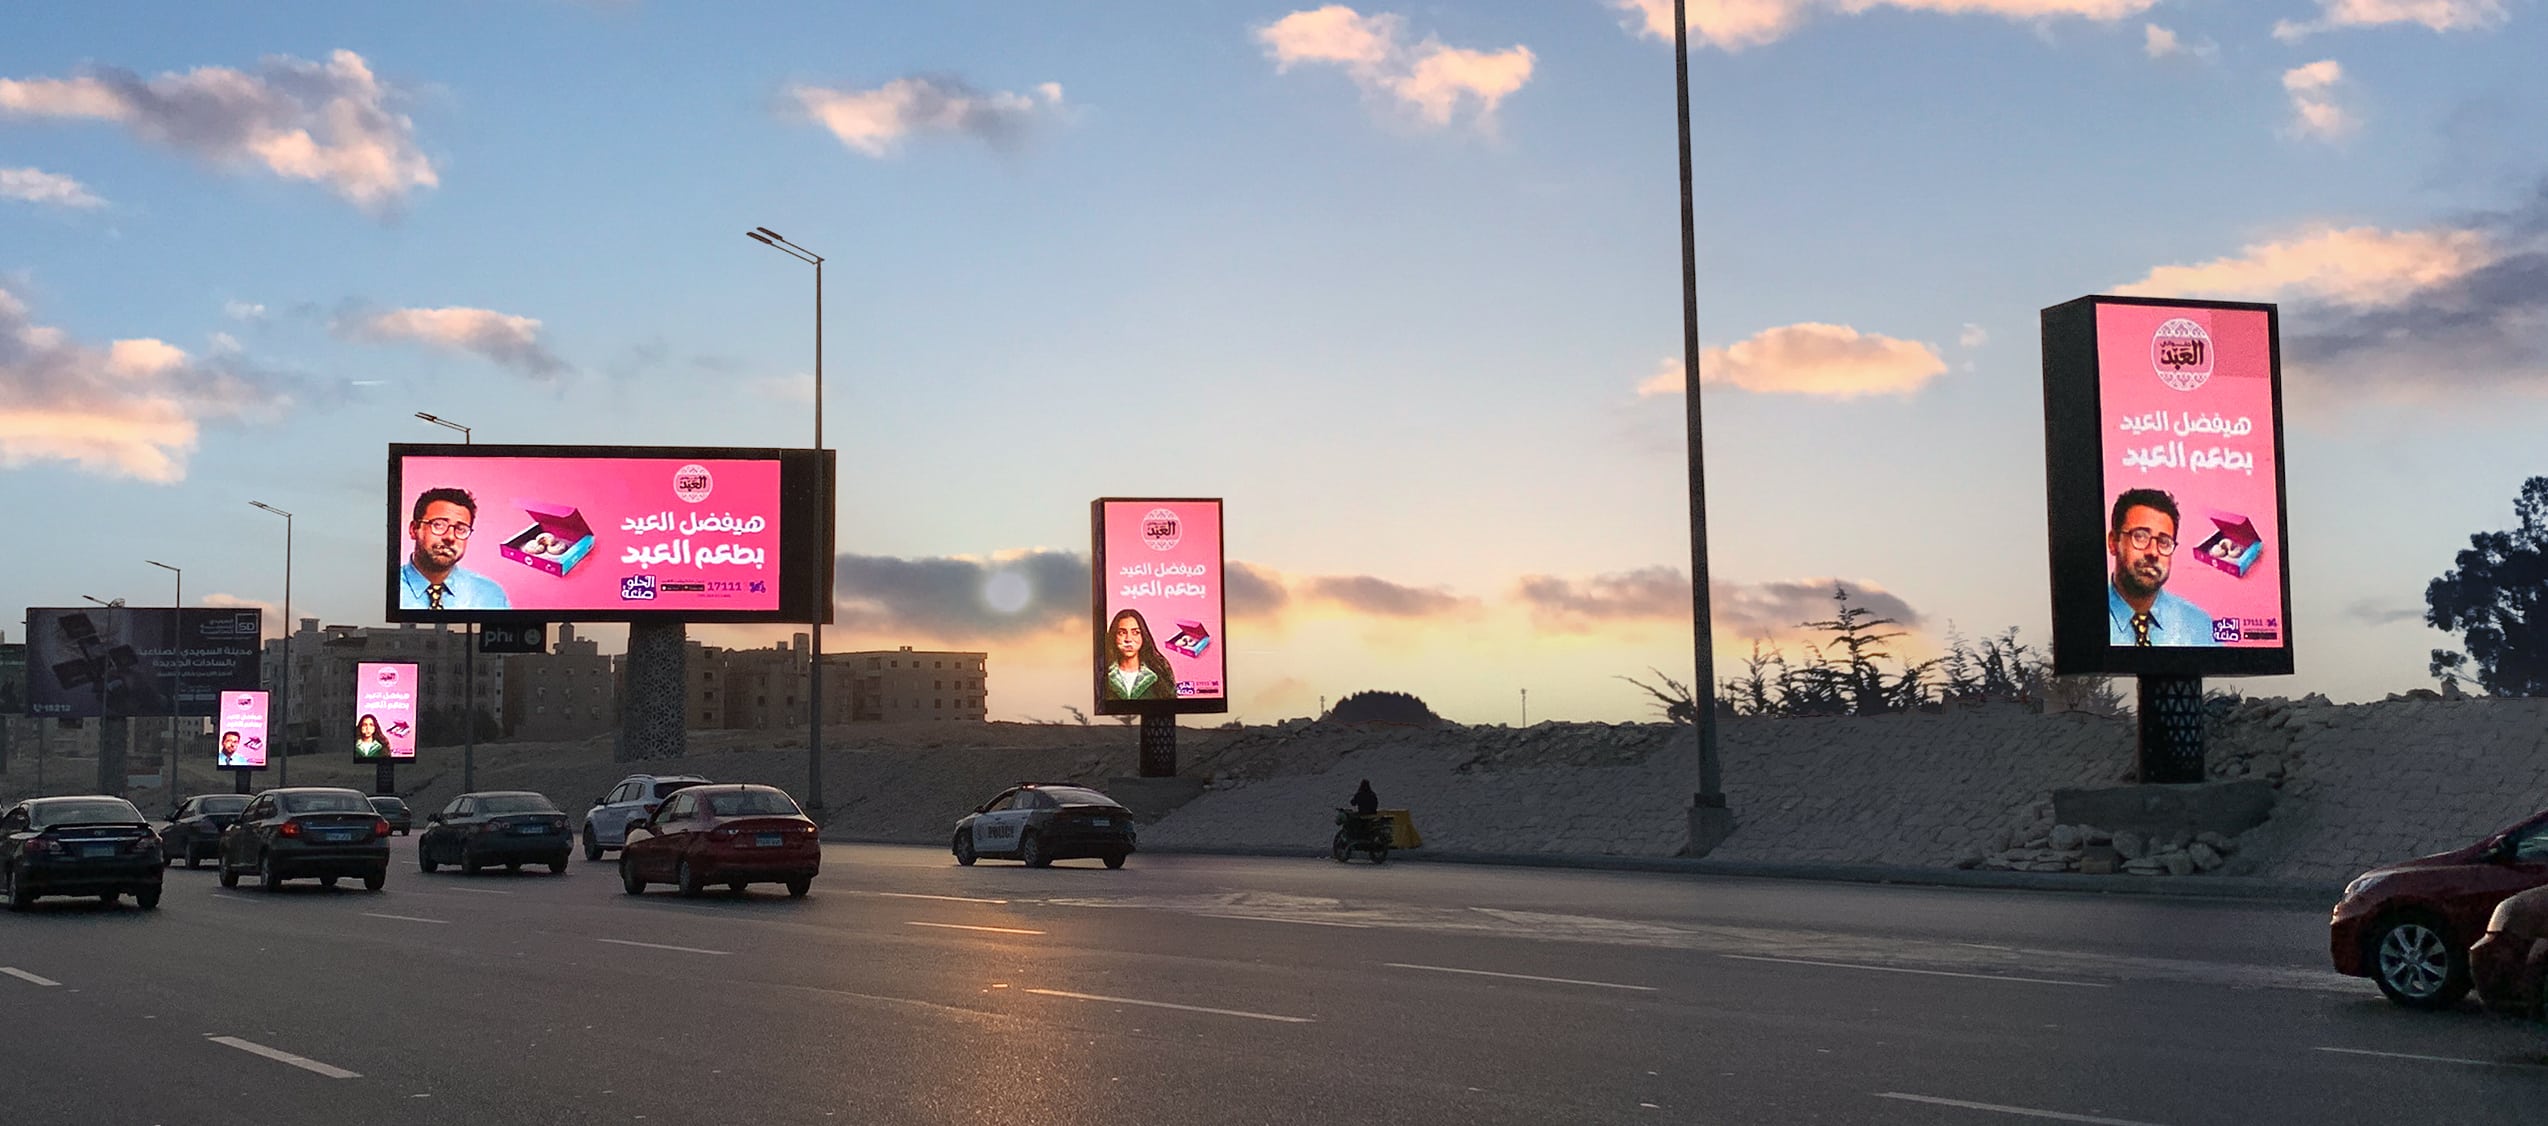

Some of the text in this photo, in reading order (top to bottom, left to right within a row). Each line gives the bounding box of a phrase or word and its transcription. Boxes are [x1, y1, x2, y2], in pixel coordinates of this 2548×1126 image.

[2120, 410, 2252, 437] هيفضل العيد
[2122, 441, 2254, 476] بطعم العبد
[620, 511, 765, 535] هيفضل العيد
[620, 540, 765, 570] بطعم العبد
[1120, 561, 1206, 578] هيفضل العيد
[623, 575, 655, 590] الحلو
[707, 581, 742, 591] 17111
[1120, 580, 1206, 600] بطعم العبد
[239, 622, 255, 631] SD
[2217, 618, 2239, 632] الحلو
[2243, 618, 2263, 626] 17111
[180, 647, 223, 657] السويدي
[223, 646, 253, 656] مدينة
[192, 658, 237, 667] بالسادات
[988, 825, 1014, 839] POLICE
